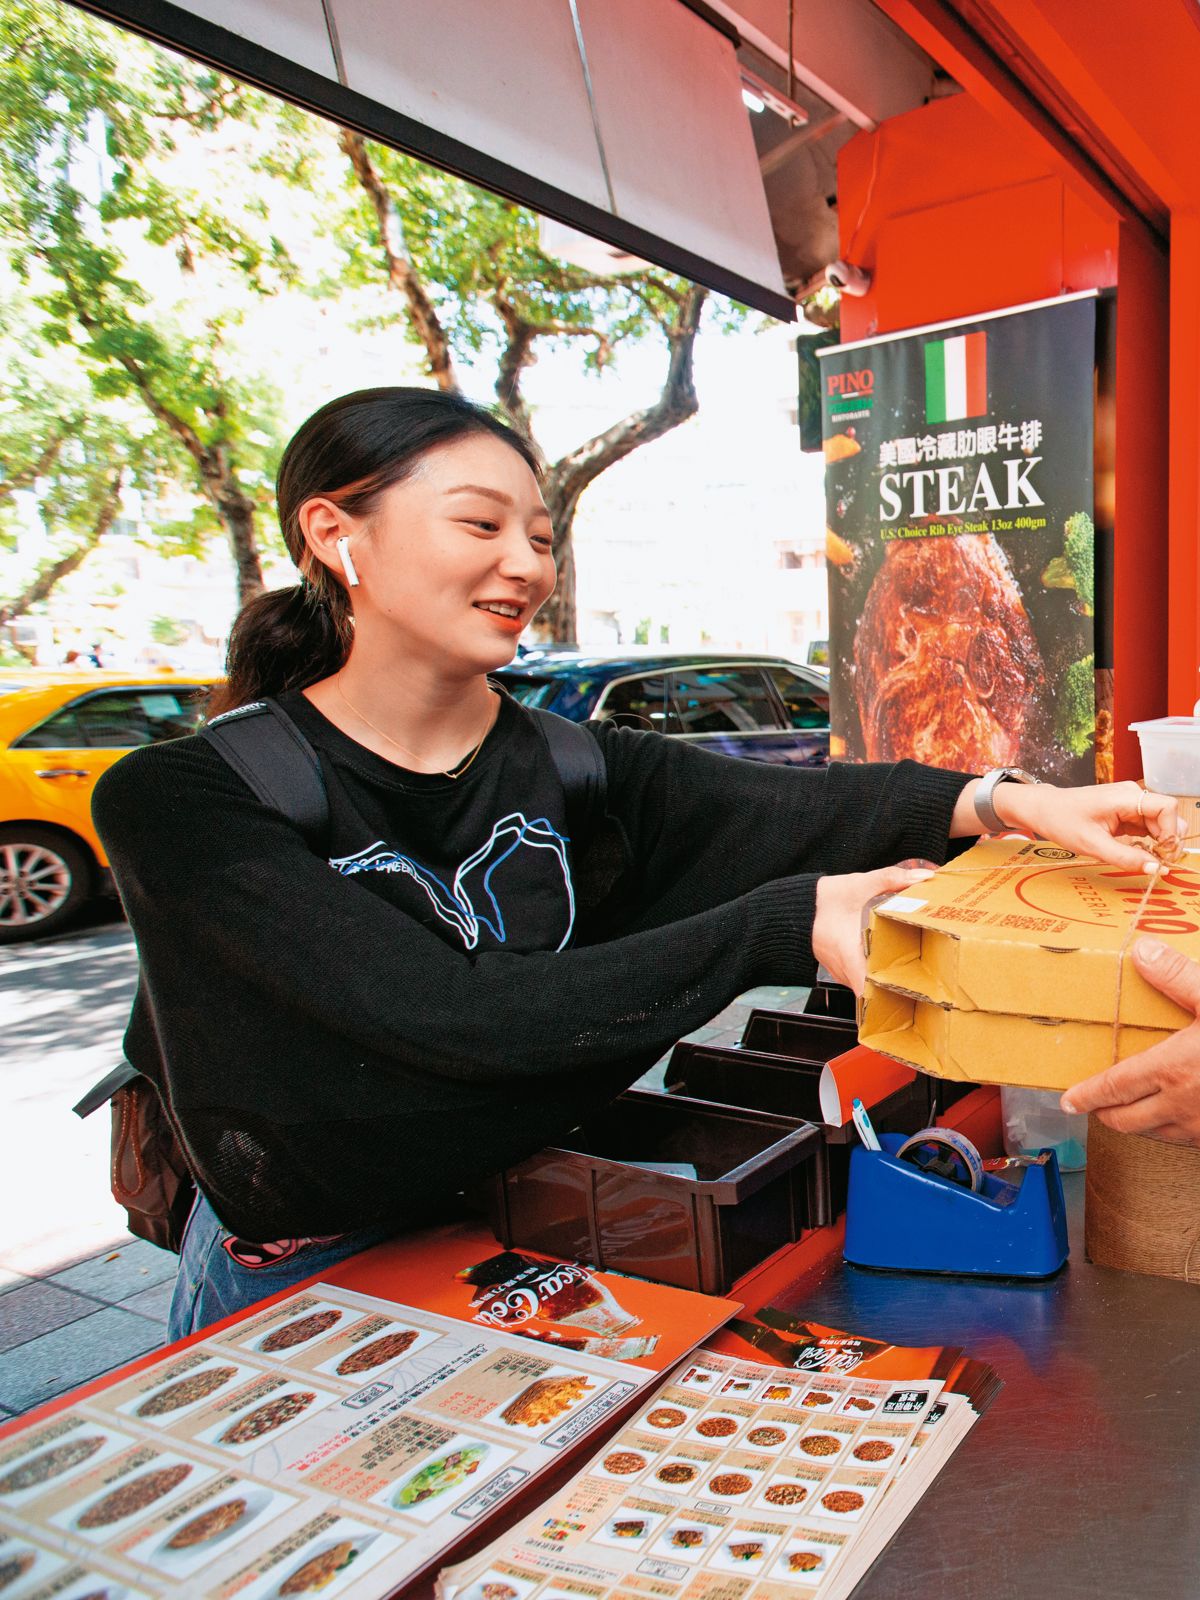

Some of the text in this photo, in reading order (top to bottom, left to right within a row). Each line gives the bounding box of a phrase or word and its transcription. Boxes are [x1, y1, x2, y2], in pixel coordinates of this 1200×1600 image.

[827, 369, 874, 396] PINO
[880, 420, 1042, 468] 美國冷藏肋眼牛排
[879, 457, 1045, 522] STEAK
[897, 525, 927, 538] Choice
[929, 524, 945, 536] Rib
[947, 523, 963, 536] Eye
[964, 520, 989, 533] Steak
[991, 518, 1013, 531] 13oz
[1014, 516, 1047, 532] 400gm
[1068, 876, 1115, 918] PIZZERIA
